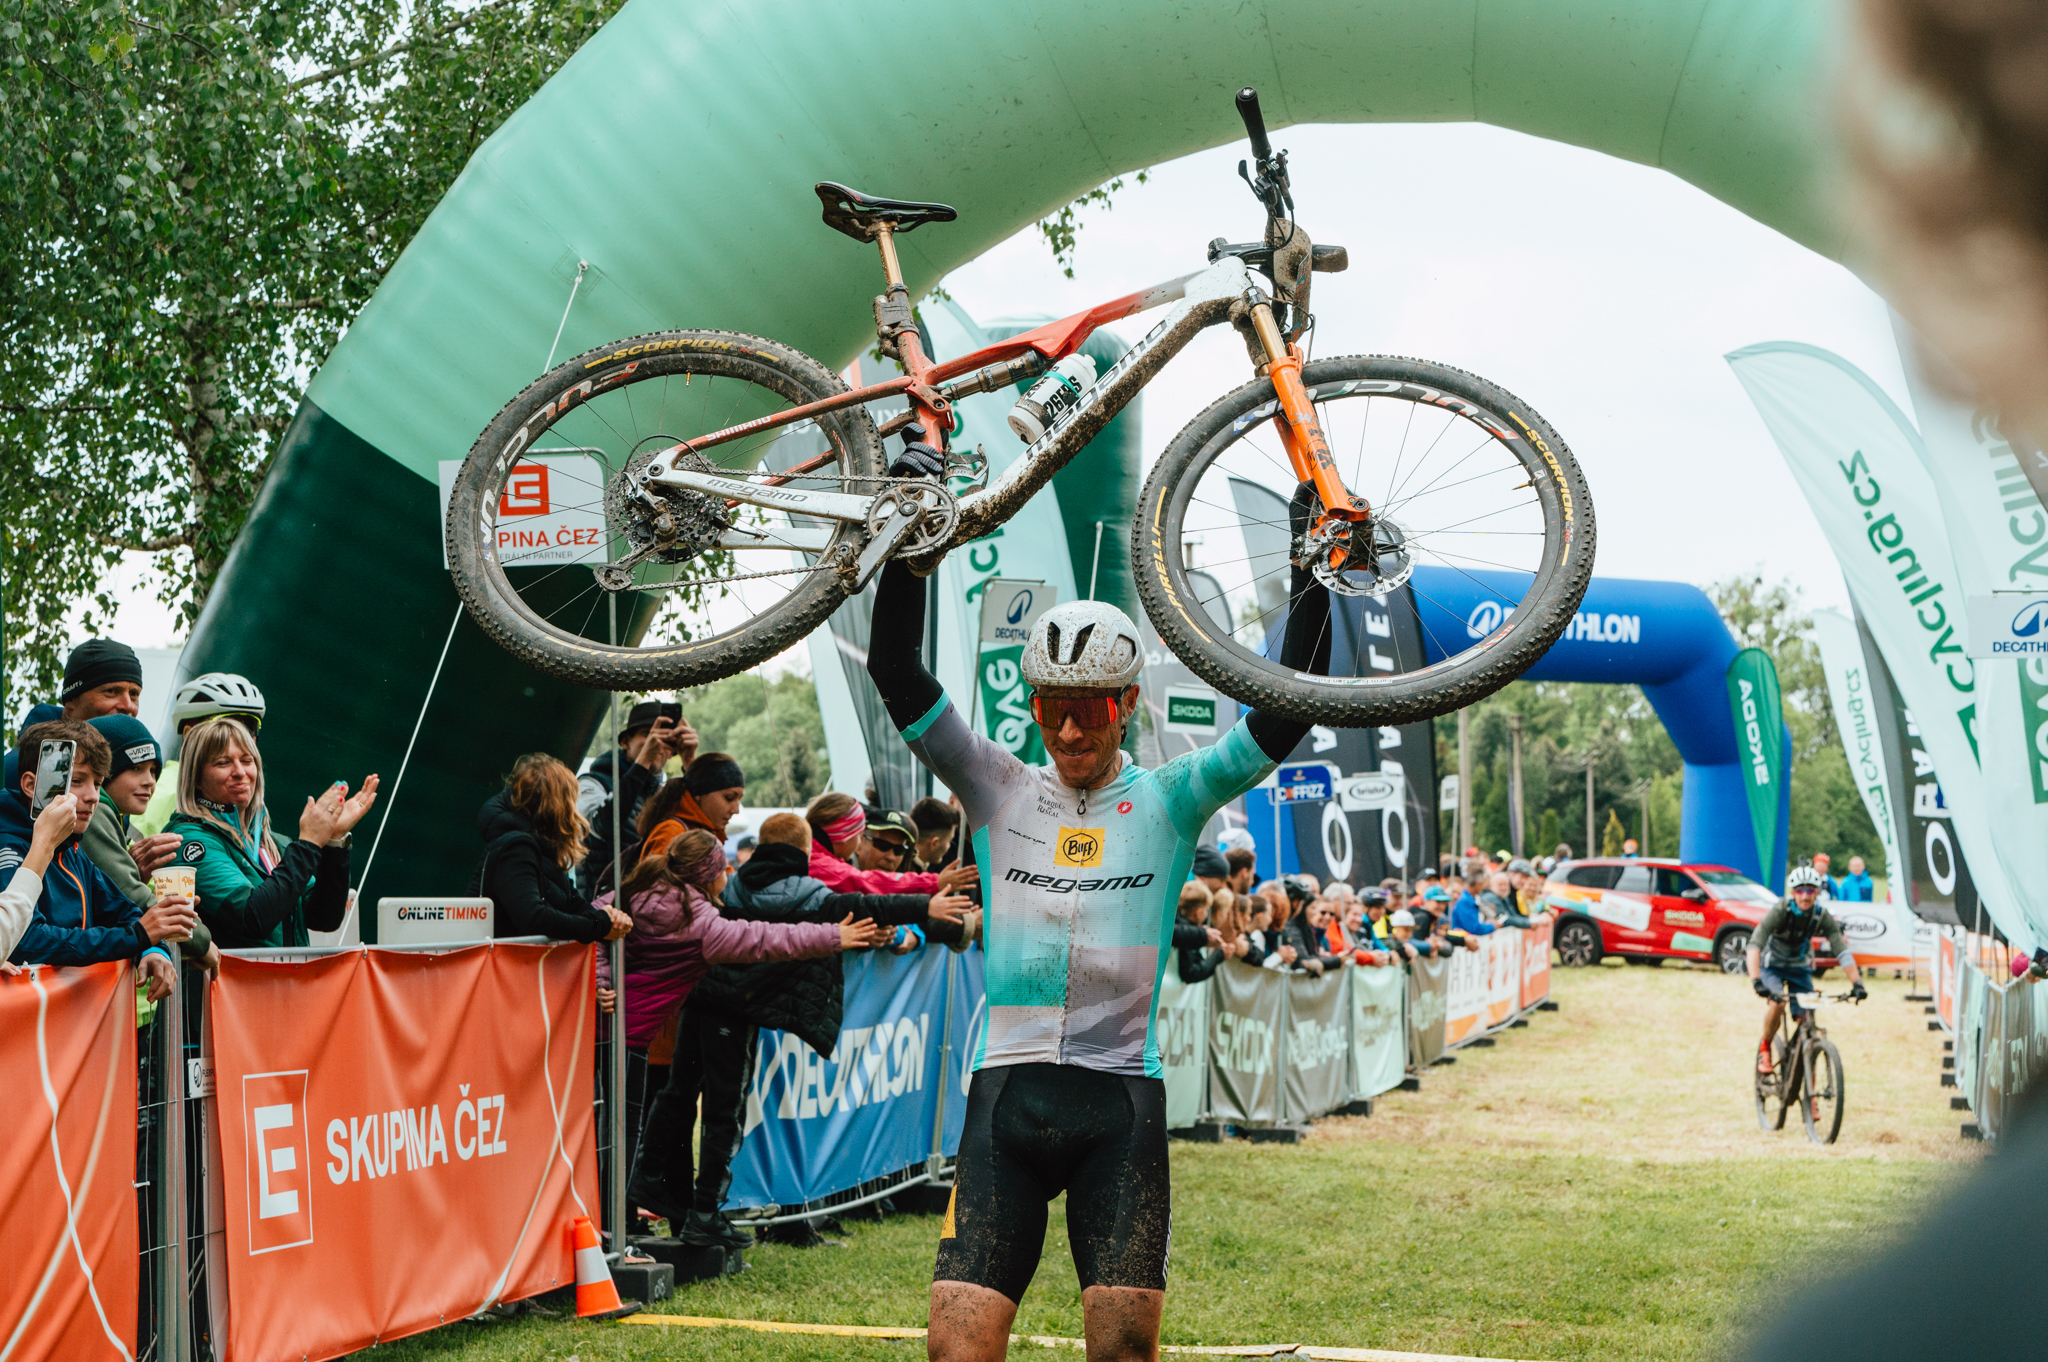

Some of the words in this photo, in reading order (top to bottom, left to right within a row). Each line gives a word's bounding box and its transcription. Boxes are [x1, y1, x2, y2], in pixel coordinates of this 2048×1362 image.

[613, 338, 733, 360] SCORPION
[1026, 319, 1168, 461] megamo
[705, 415, 772, 441] SHIMANO
[1526, 429, 1574, 521] SCORPION
[706, 478, 808, 502] megamo
[499, 530, 550, 548] PINA
[556, 525, 599, 546] ČEZ
[500, 551, 532, 561] ERÁLNÍ
[533, 550, 573, 561] PARTNER
[1151, 526, 1183, 608] PIRELLI
[995, 627, 1029, 640] DECATHL
[1993, 641, 2048, 653] DECATH
[62, 681, 79, 695] CRAFT
[1004, 867, 1155, 894] megamo
[777, 1013, 929, 1119] DECATHLON
[326, 1104, 449, 1185] SKUPINA
[454, 1083, 507, 1160] ČEZ
